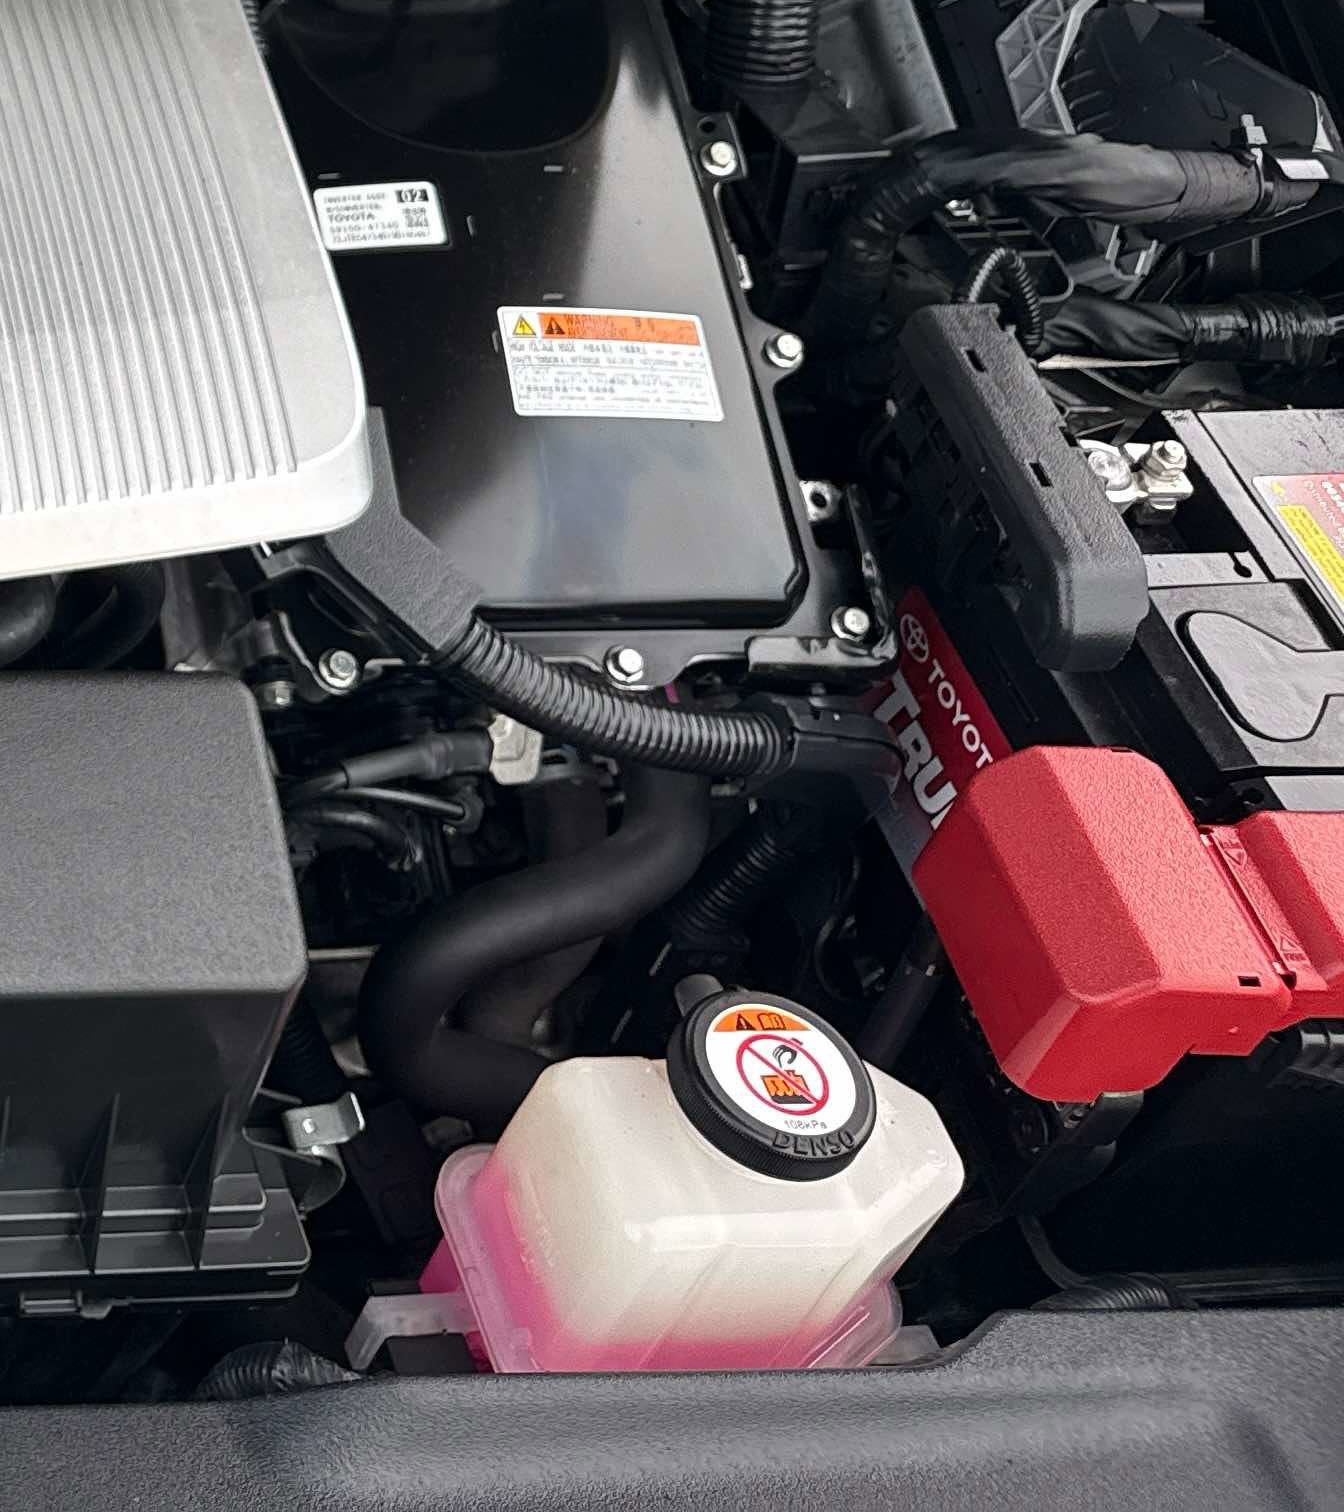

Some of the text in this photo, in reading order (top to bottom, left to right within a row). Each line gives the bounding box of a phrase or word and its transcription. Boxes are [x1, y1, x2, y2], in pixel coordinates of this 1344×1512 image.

[400, 189, 425, 202] 02
[328, 213, 375, 224] TOYOTA
[928, 659, 993, 769] TOYOT
[873, 668, 958, 831] TRU
[772, 1130, 856, 1157] DENSO
